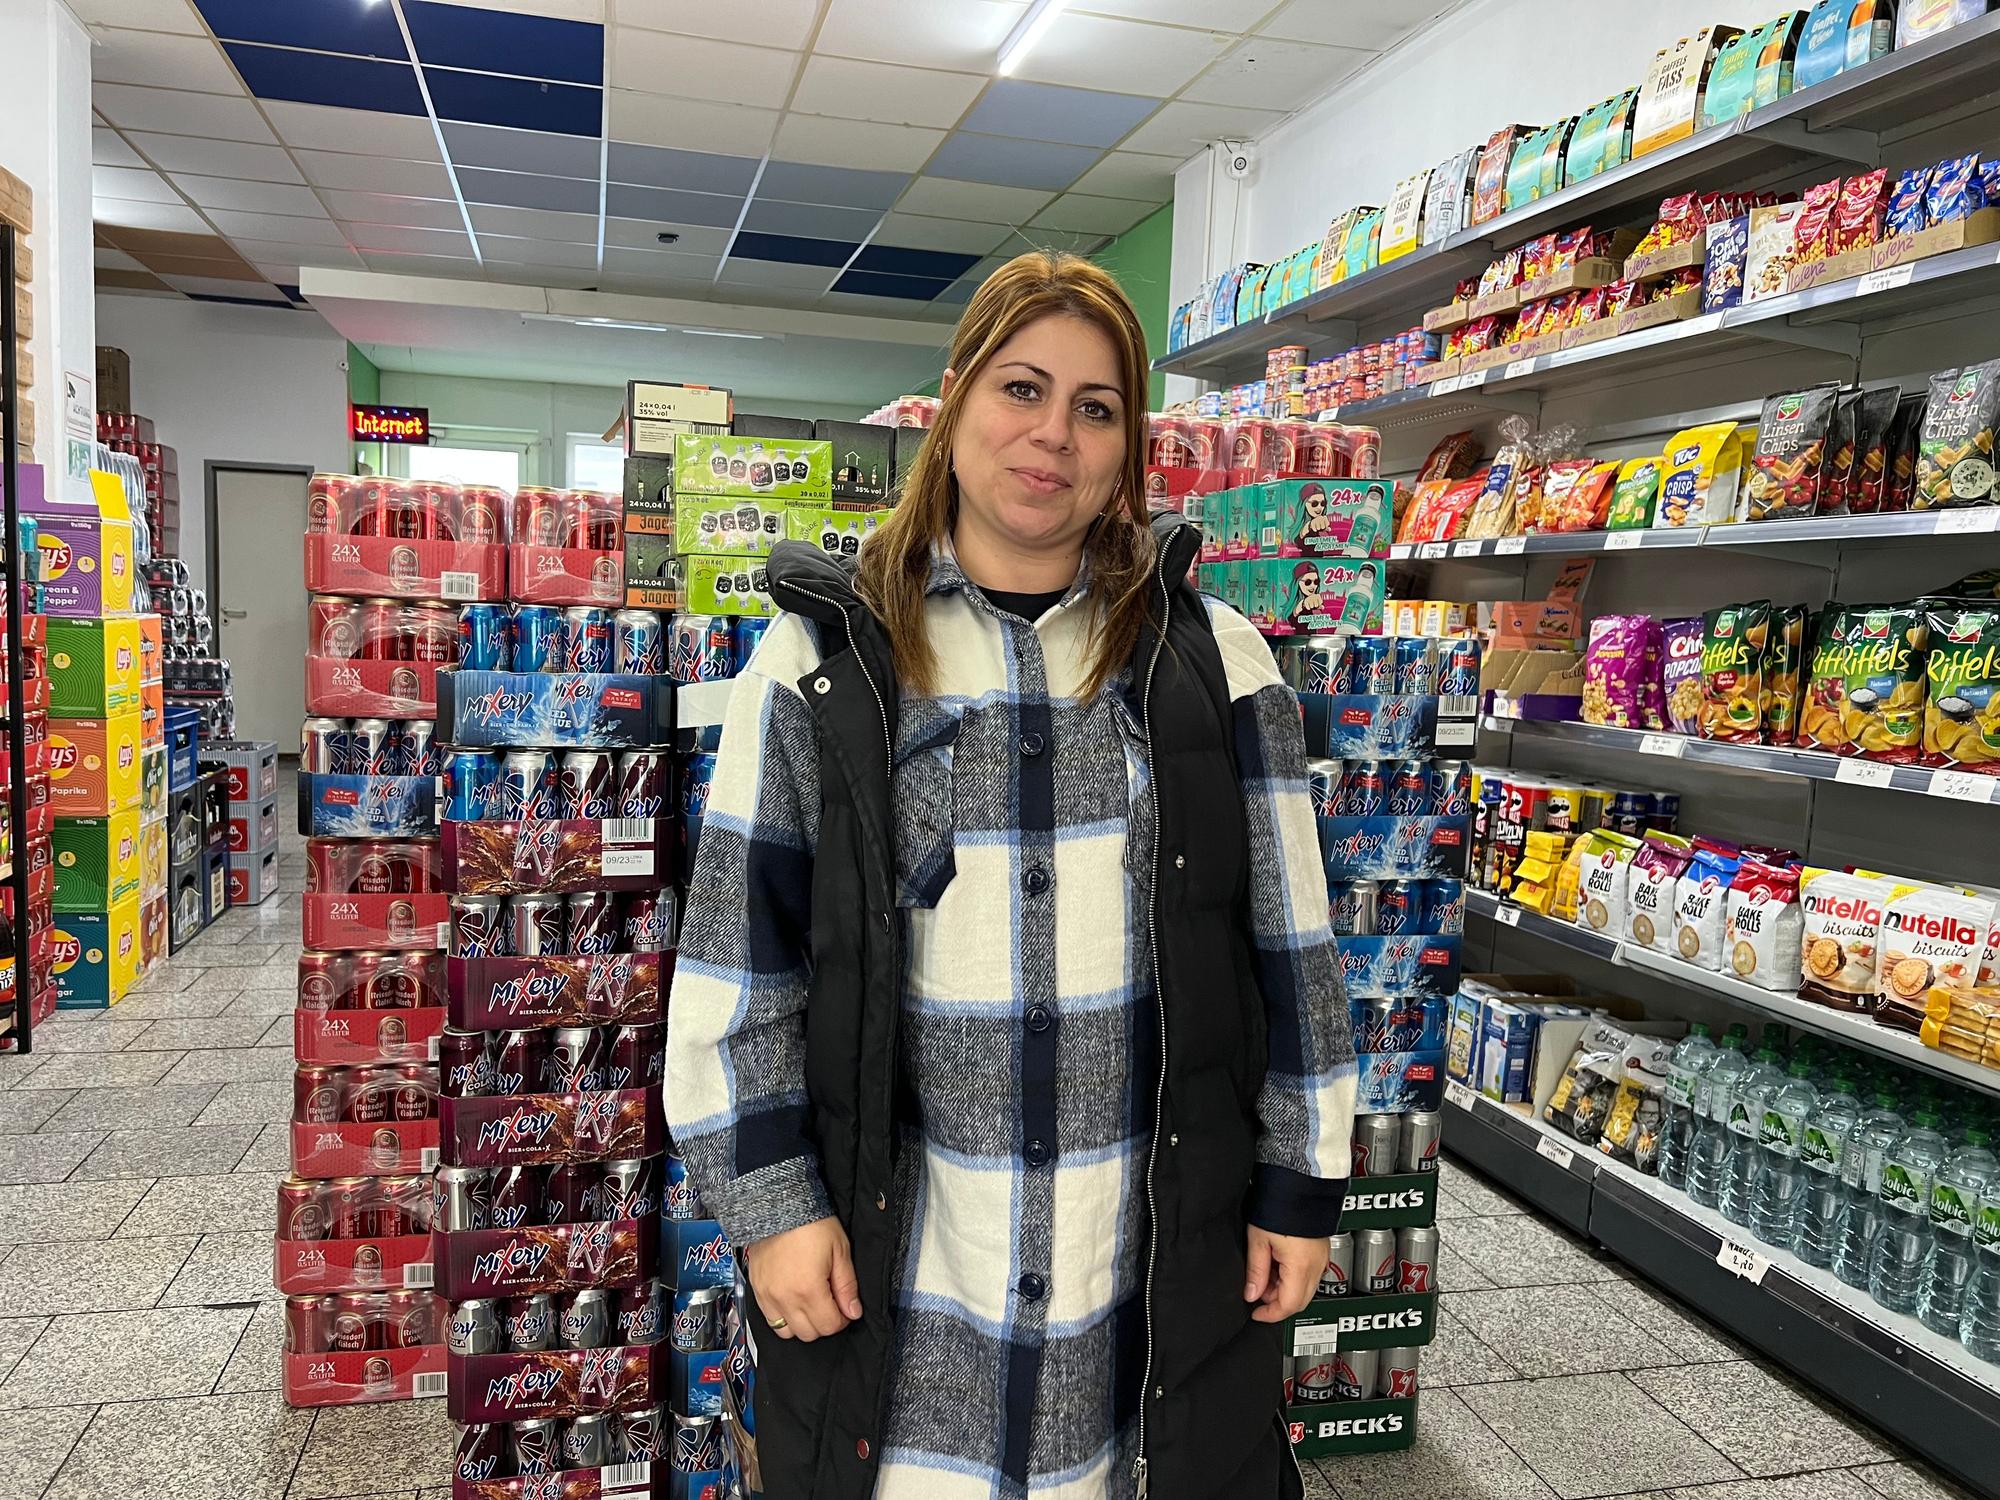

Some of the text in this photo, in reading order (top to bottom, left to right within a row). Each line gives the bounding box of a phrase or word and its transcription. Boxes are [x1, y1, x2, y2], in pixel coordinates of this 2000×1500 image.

[1661, 55, 1687, 74] GAFFELS
[1657, 67, 1685, 96] FASS
[1395, 198, 1412, 216] FASS
[1927, 403, 1978, 422] Linsen
[355, 411, 423, 435] Internet
[1761, 422, 1805, 439] Linsen
[1926, 421, 1970, 442] Chips
[1760, 438, 1799, 456] Chips
[1674, 449, 1698, 466] TUC
[855, 486, 870, 494] 35%
[1666, 481, 1693, 496] CRISP
[332, 545, 360, 557] 24X
[537, 555, 565, 567] 24X
[43, 596, 78, 606] Pepper
[1670, 632, 1703, 658] Chi
[1843, 640, 1911, 676] Riffels
[1927, 645, 2000, 682] Riffels
[333, 667, 361, 680] 24X
[1664, 657, 1701, 679] POPCO
[50, 744, 77, 769] y's
[50, 786, 88, 797] Paprika
[606, 856, 630, 865] 09/23
[330, 902, 359, 914] 24X
[1634, 892, 1657, 908] ROLLS
[1687, 893, 1711, 909] BAKE
[1737, 905, 1763, 922] BAKE
[1804, 894, 1881, 925] nutella
[1735, 917, 1761, 933] ROLLS
[1822, 920, 1877, 939] biscuits
[1884, 909, 1976, 946] nutella
[637, 936, 661, 945] COLA
[1912, 941, 1971, 958] biscuits
[54, 940, 78, 964] y's
[488, 968, 570, 1016] MiXery
[321, 1020, 350, 1031] 24X
[315, 1133, 343, 1144] 24X
[477, 1106, 557, 1154] MiXery
[1759, 1119, 1790, 1142] Volvic
[1801, 1135, 1831, 1158] Volvic
[1882, 1172, 1916, 1198] Volvic
[1342, 1189, 1424, 1211] BECK'S
[1931, 1193, 1967, 1220] Volvic
[298, 1250, 325, 1261] 24X
[472, 1238, 551, 1287] MiXery
[1338, 1308, 1423, 1333] BECK'S
[514, 1335, 537, 1344] COLA
[631, 1327, 656, 1337] COLA
[677, 1339, 697, 1348] BLUE
[308, 1361, 335, 1373] 24X
[485, 1363, 564, 1410] MiXery
[1318, 1414, 1404, 1438] BECK'S
